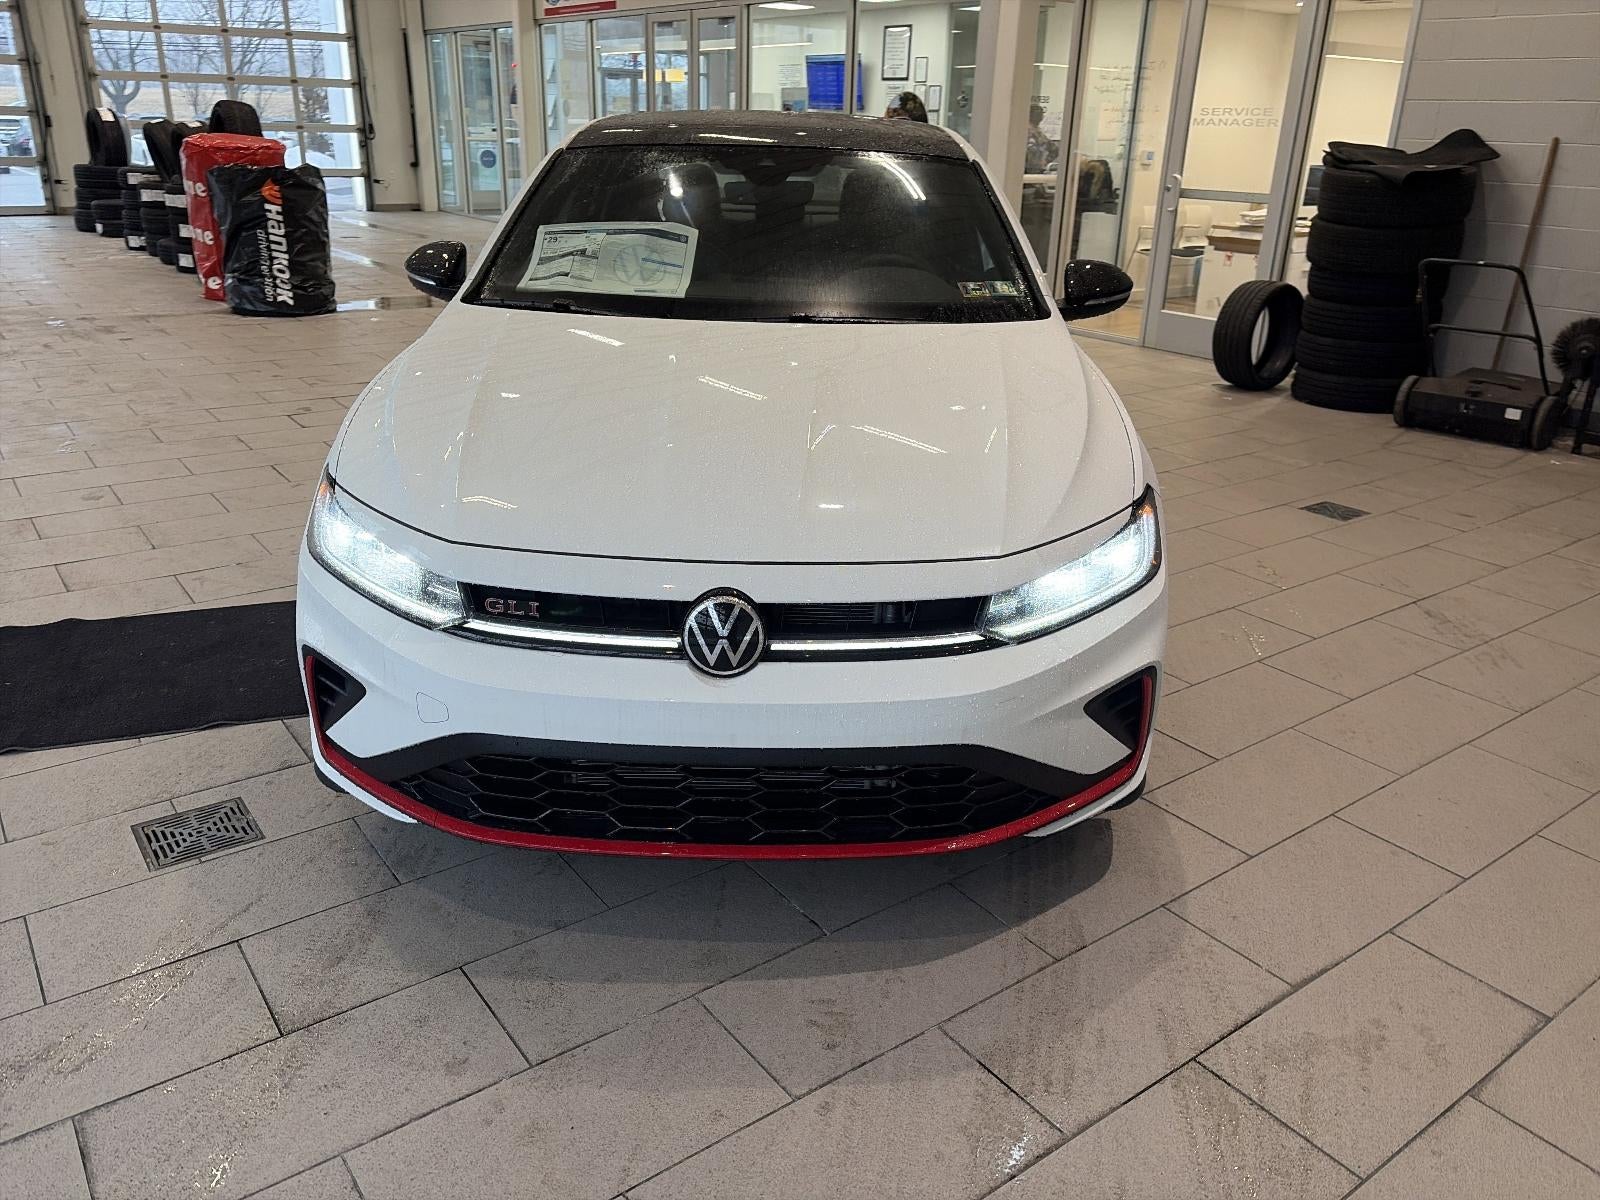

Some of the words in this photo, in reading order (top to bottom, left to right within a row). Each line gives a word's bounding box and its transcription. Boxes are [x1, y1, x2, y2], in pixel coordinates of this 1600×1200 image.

[1199, 107, 1274, 117] SERVICE
[1192, 118, 1279, 127] MANAGER
[484, 597, 539, 618] GLI
